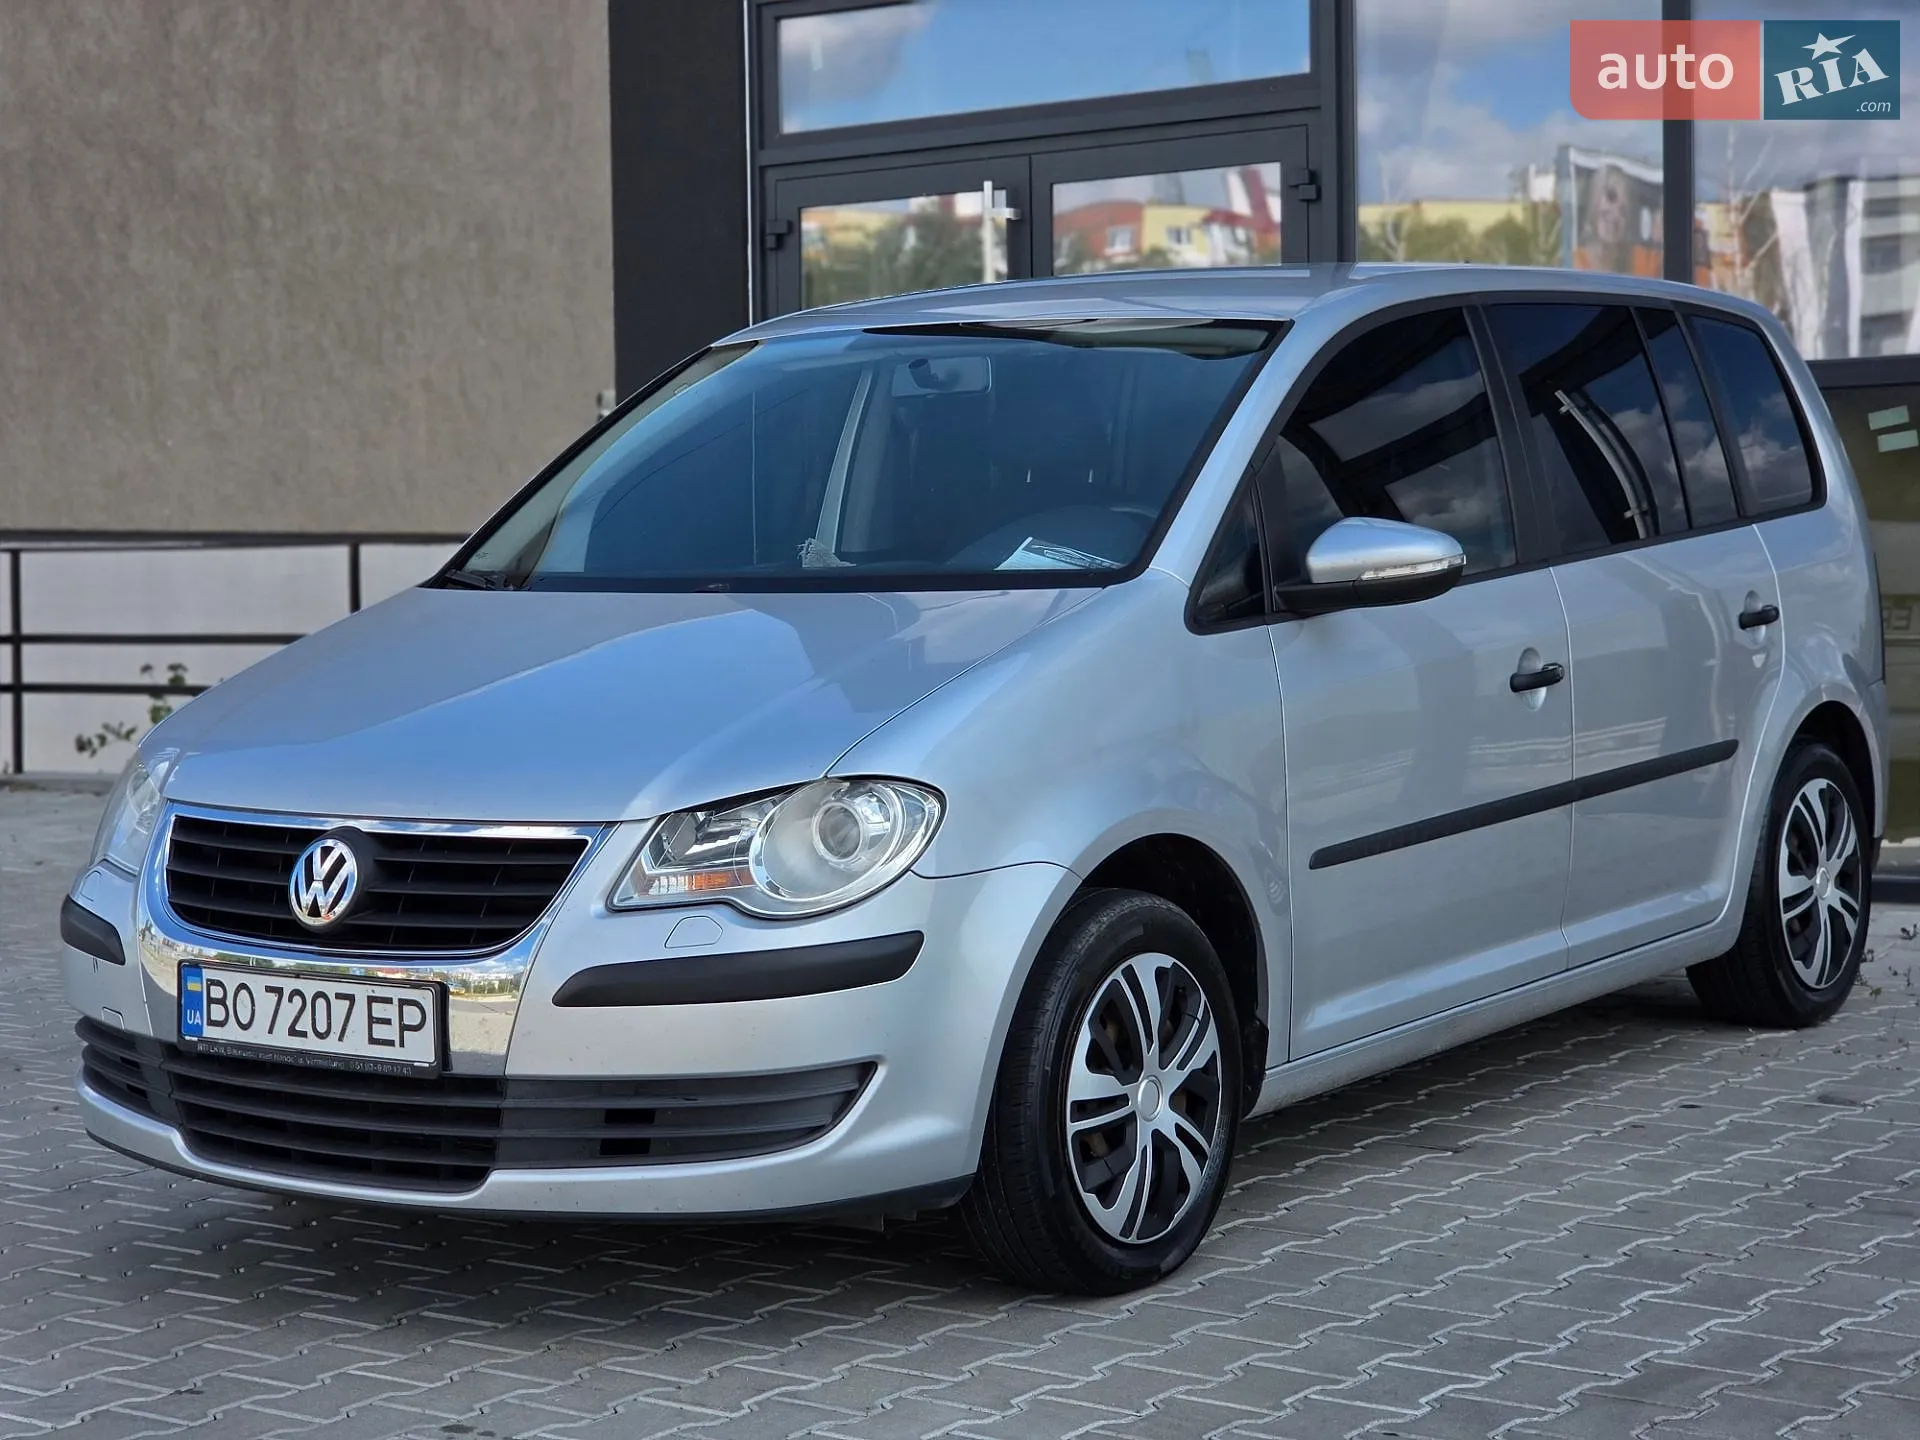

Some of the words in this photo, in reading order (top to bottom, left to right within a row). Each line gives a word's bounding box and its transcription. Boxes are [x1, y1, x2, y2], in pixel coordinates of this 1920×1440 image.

[186, 1009, 202, 1025] UA
[205, 978, 256, 1031] BO
[264, 985, 356, 1042] 7207
[367, 995, 427, 1048] EP
